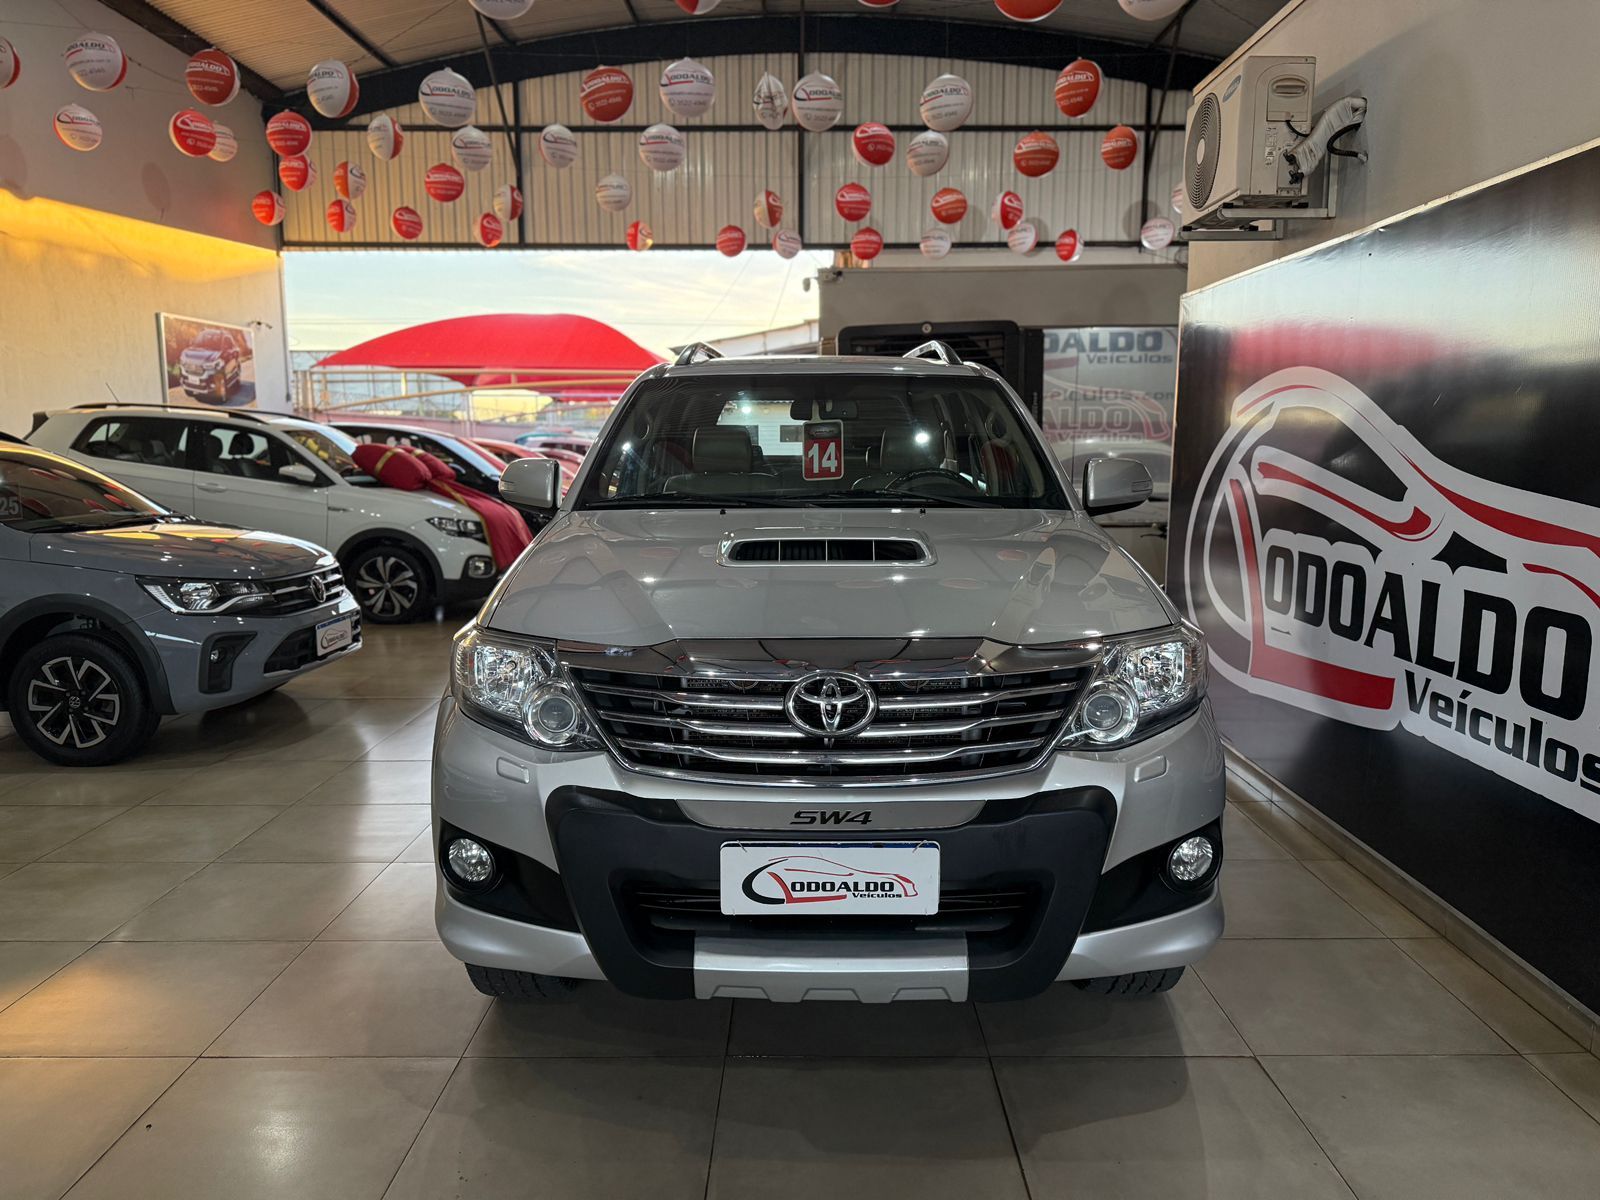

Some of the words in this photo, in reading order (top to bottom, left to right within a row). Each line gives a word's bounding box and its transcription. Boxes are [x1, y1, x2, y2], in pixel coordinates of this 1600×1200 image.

[808, 442, 838, 473] 14
[1405, 670, 1600, 796] Veículos
[789, 810, 873, 825] SW4
